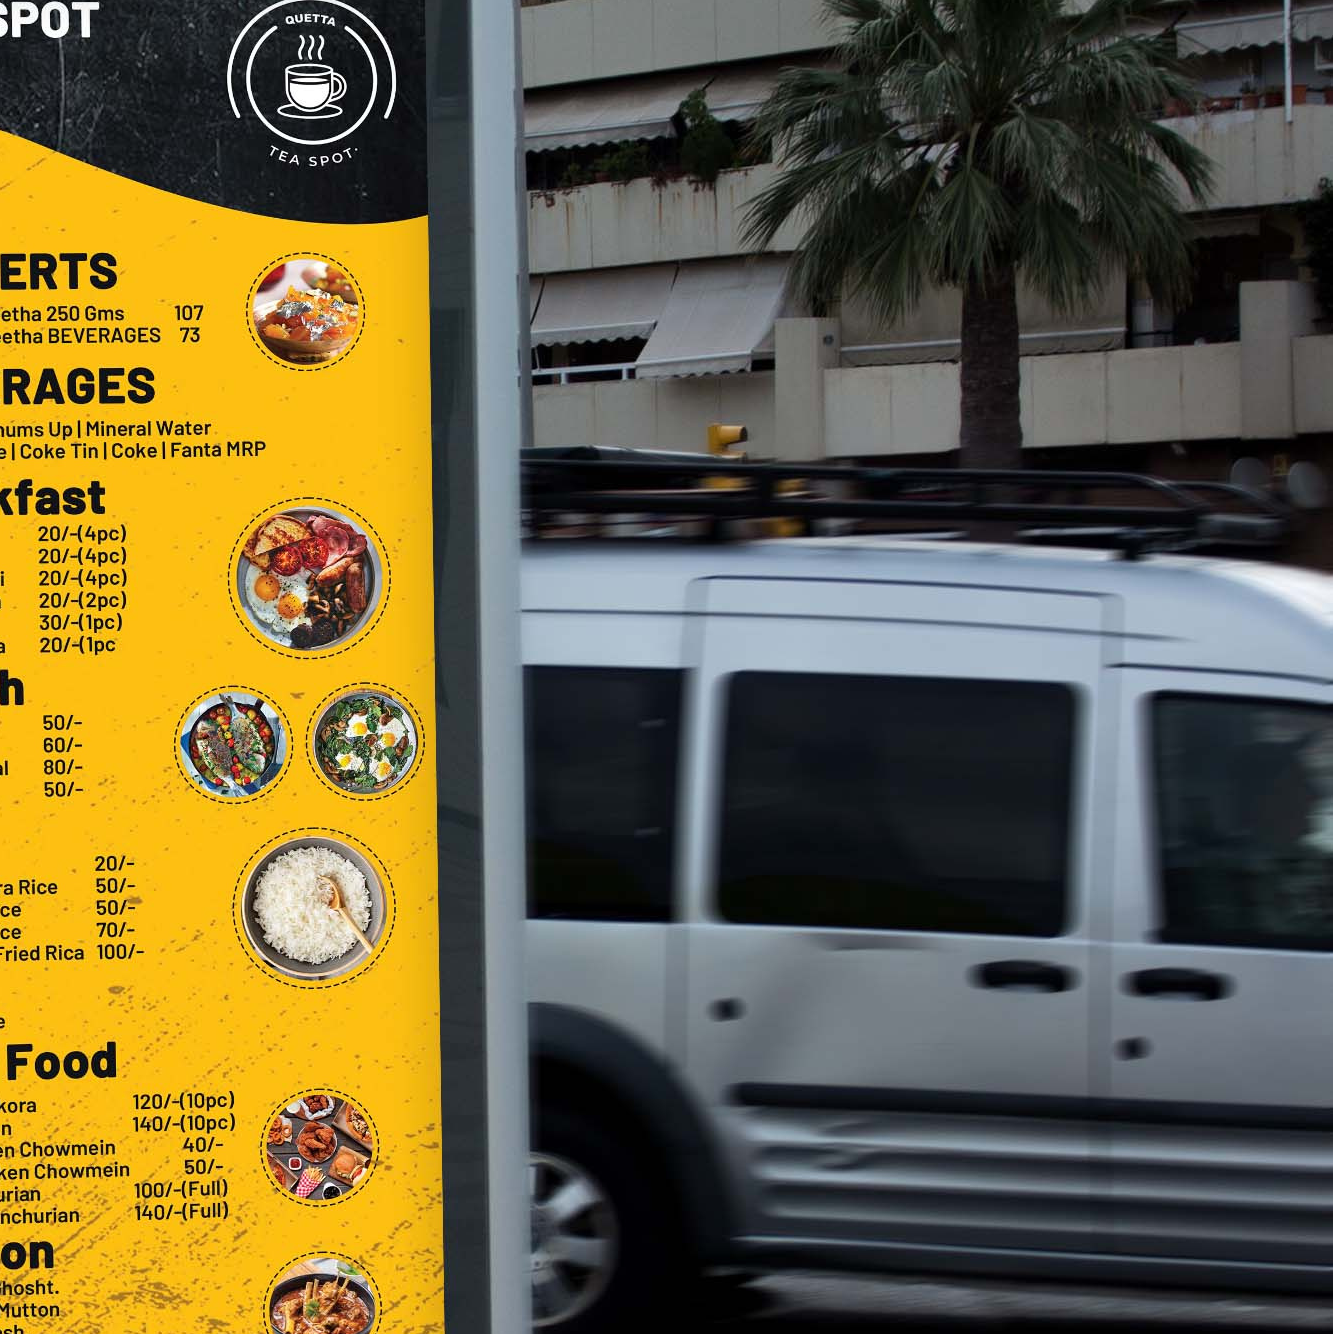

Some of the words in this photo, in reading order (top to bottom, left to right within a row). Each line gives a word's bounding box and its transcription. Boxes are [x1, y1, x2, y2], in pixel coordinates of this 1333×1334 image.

[285, 13, 336, 27] QUETTA
[269, 145, 300, 166] TEA
[47, 306, 79, 321] 250
[85, 306, 124, 321] Gms
[175, 306, 203, 320] 107
[49, 328, 160, 343] BEVERAGES
[180, 328, 199, 342] 73
[39, 525, 126, 544] 20/-(4pc)
[40, 591, 126, 611] 20/-(2pc)
[41, 636, 115, 655] 20/-(1pc
[44, 715, 82, 730] 50/-
[44, 760, 82, 774] 80/-
[96, 856, 134, 871] 20/-
[97, 900, 135, 915] 50/-
[46, 945, 83, 960] Rica
[98, 944, 143, 959] 100/-
[7, 1042, 116, 1080] Food
[133, 1091, 234, 1111] 120/-(10pc)
[35, 1162, 129, 1179] Chowmein
[185, 1159, 223, 1174] 50/-
[135, 1202, 228, 1220] 140/-(Full)
